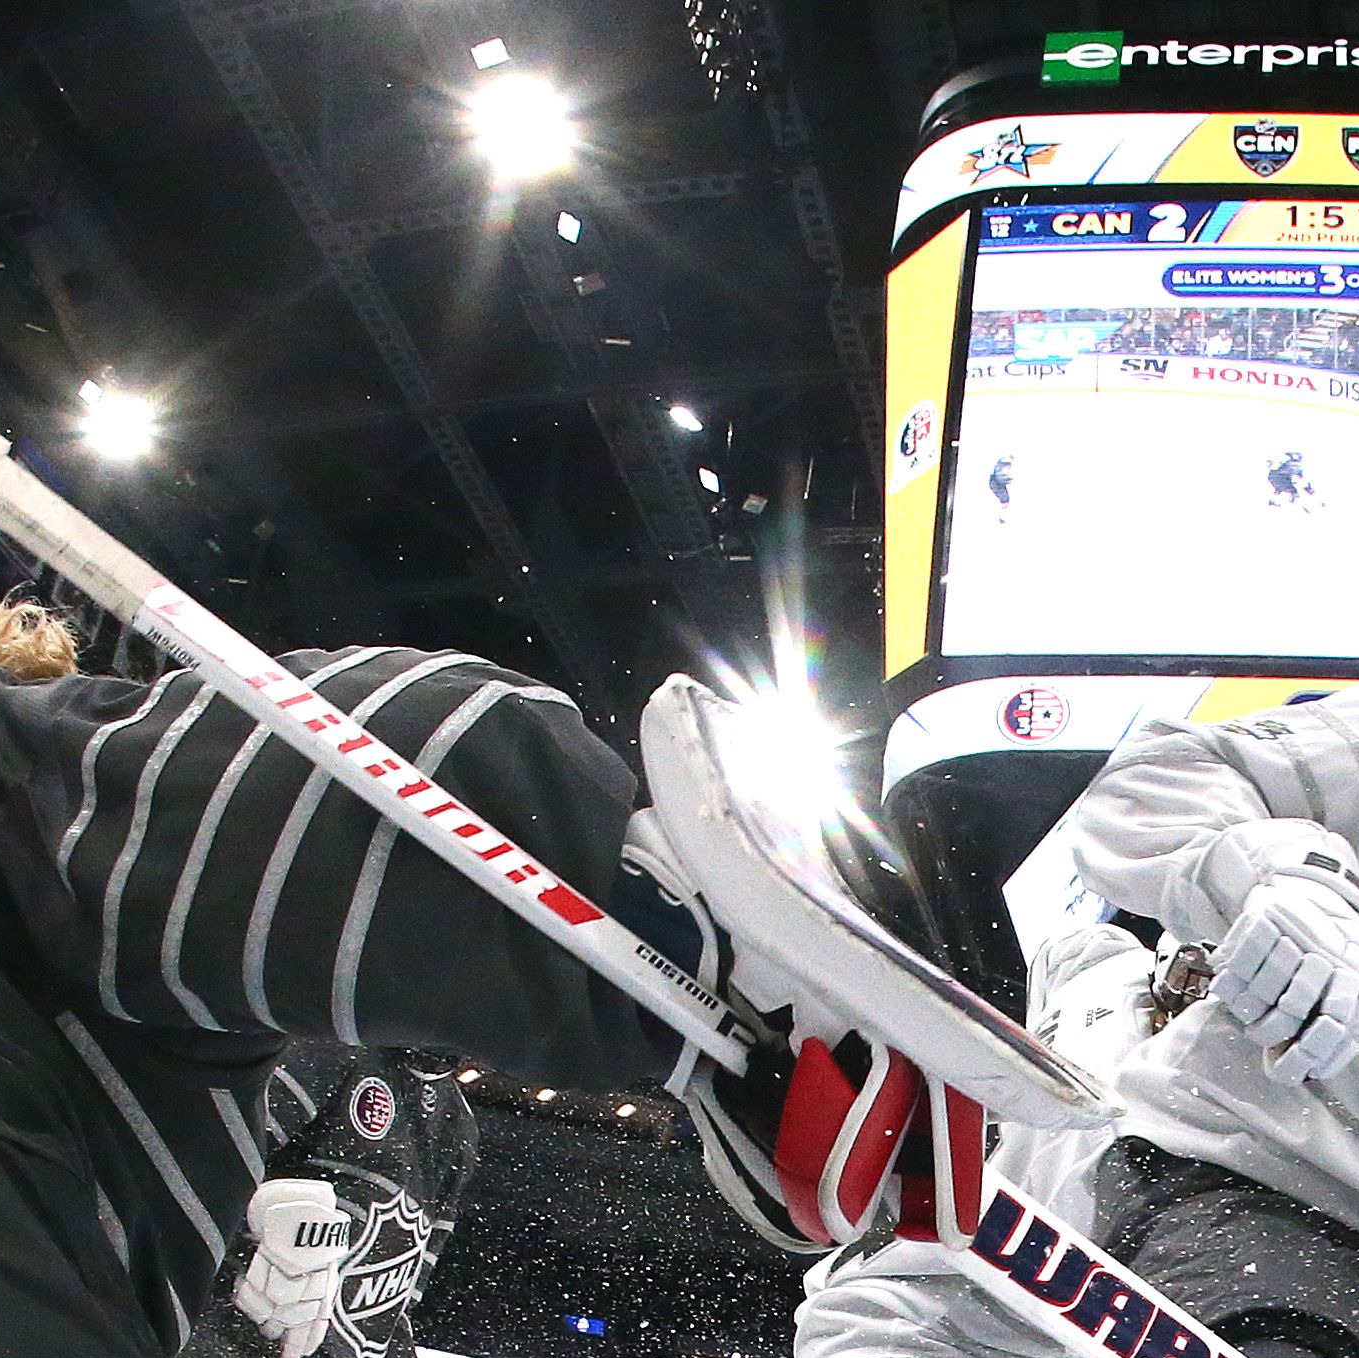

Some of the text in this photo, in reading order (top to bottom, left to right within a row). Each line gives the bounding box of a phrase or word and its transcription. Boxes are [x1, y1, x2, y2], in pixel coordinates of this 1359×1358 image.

[1236, 135, 1295, 152] CEN
[1051, 203, 1187, 242] CAN 2
[1276, 232, 1312, 243] 2ND
[1171, 270, 1223, 285] ELITE
[1319, 265, 1345, 295] 3
[1121, 358, 1169, 374] SN
[1193, 366, 1318, 392] HONDA
[635, 943, 719, 1011] CUSTOM
[349, 1258, 416, 1310] NHL
